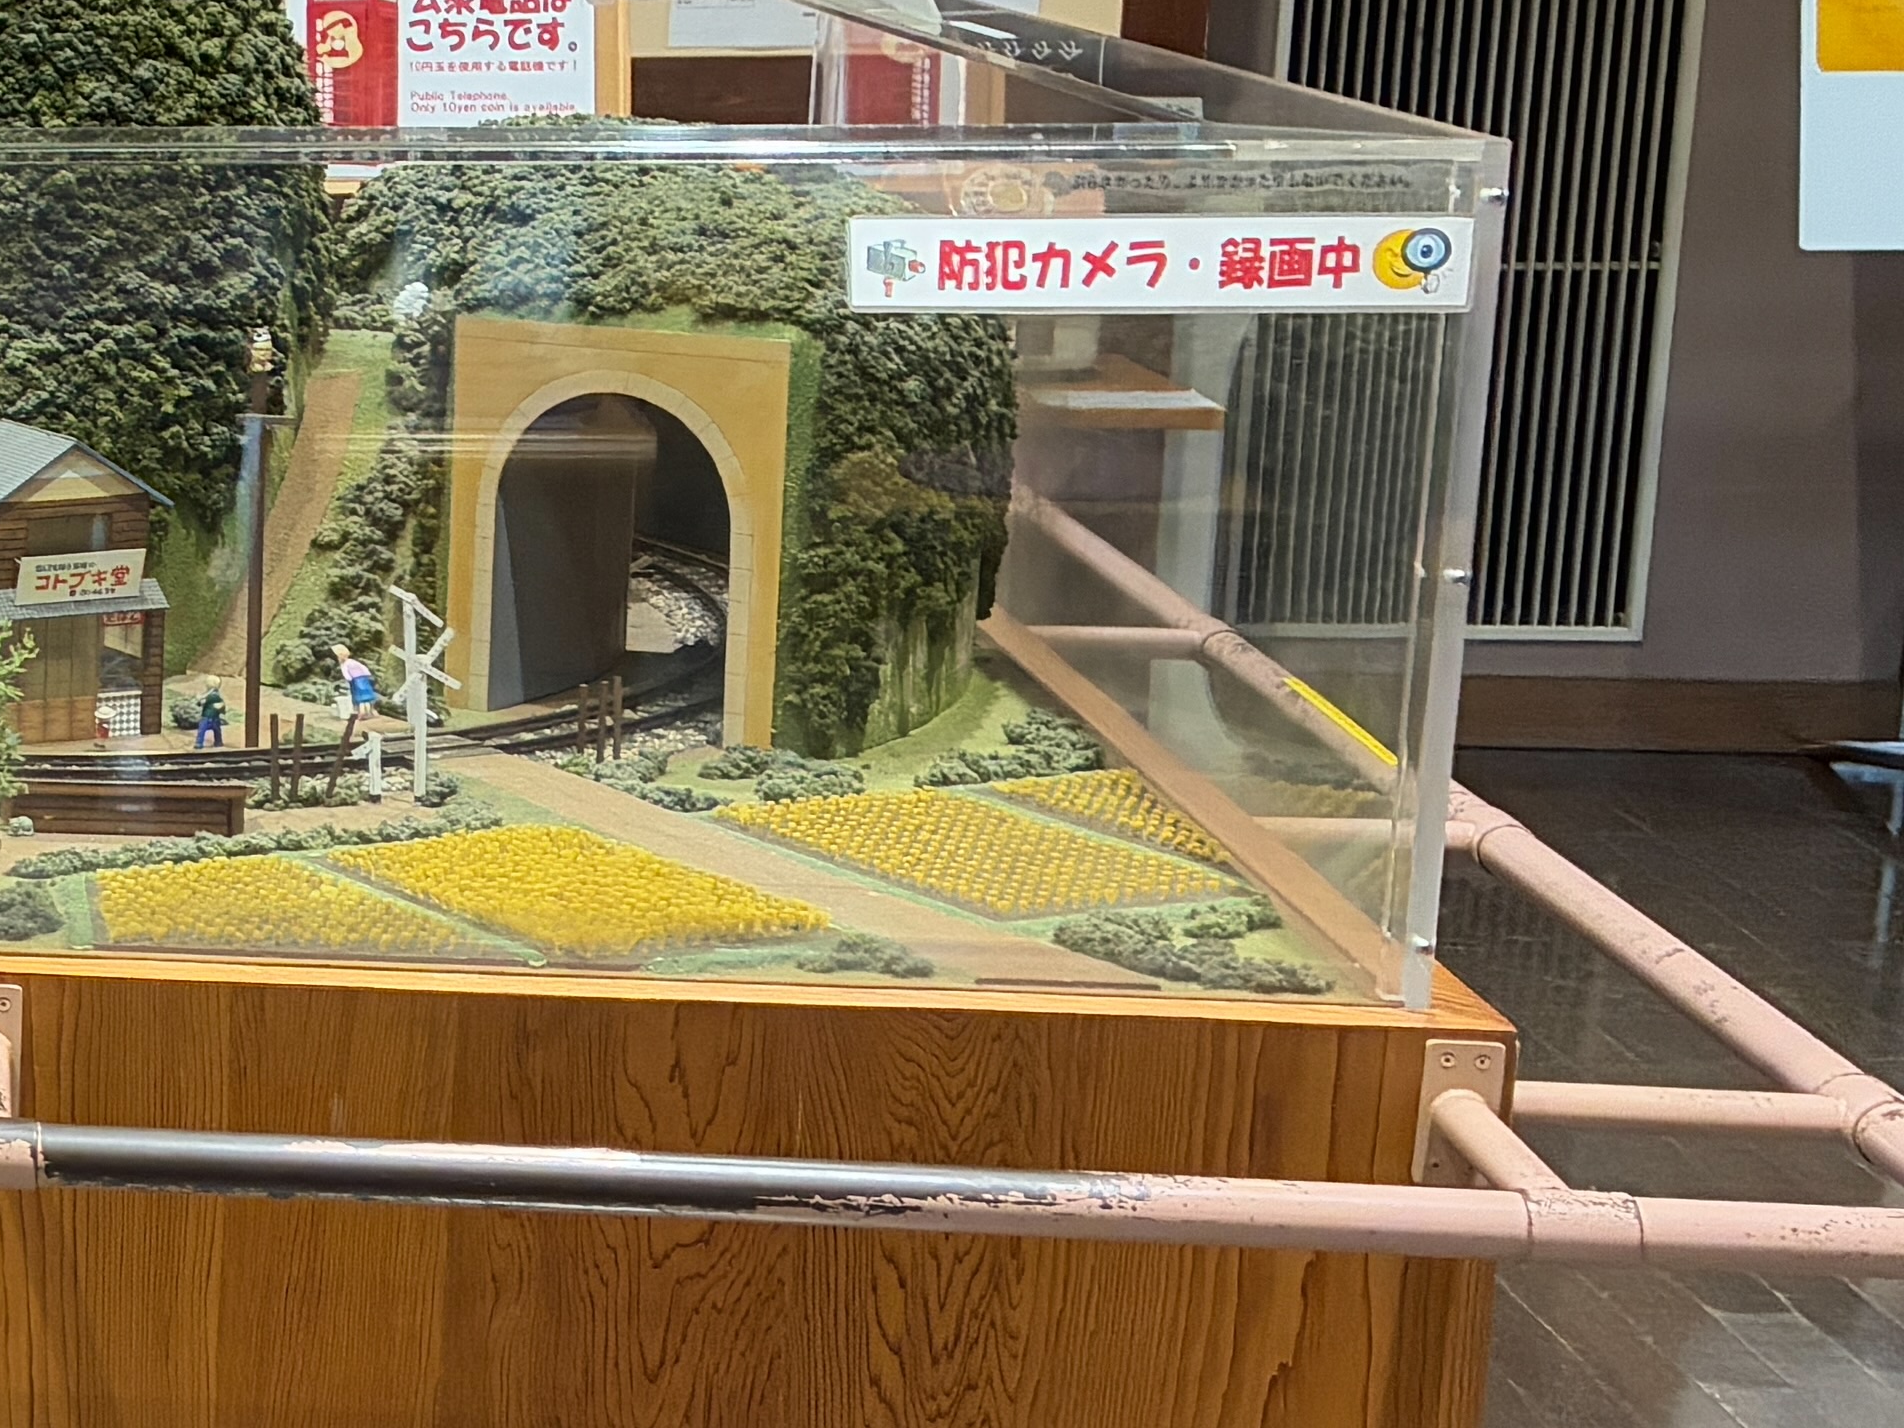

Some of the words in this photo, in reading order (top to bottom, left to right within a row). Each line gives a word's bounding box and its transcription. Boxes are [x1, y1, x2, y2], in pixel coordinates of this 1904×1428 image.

[406, 17, 577, 53] こちらです。
[411, 91, 443, 102] Public
[411, 103, 435, 114] Only
[481, 103, 505, 112] coin
[509, 102, 519, 112] is
[936, 235, 1362, 291] 防犯カメラ・録画中
[35, 564, 130, 591] コトブキ堂
